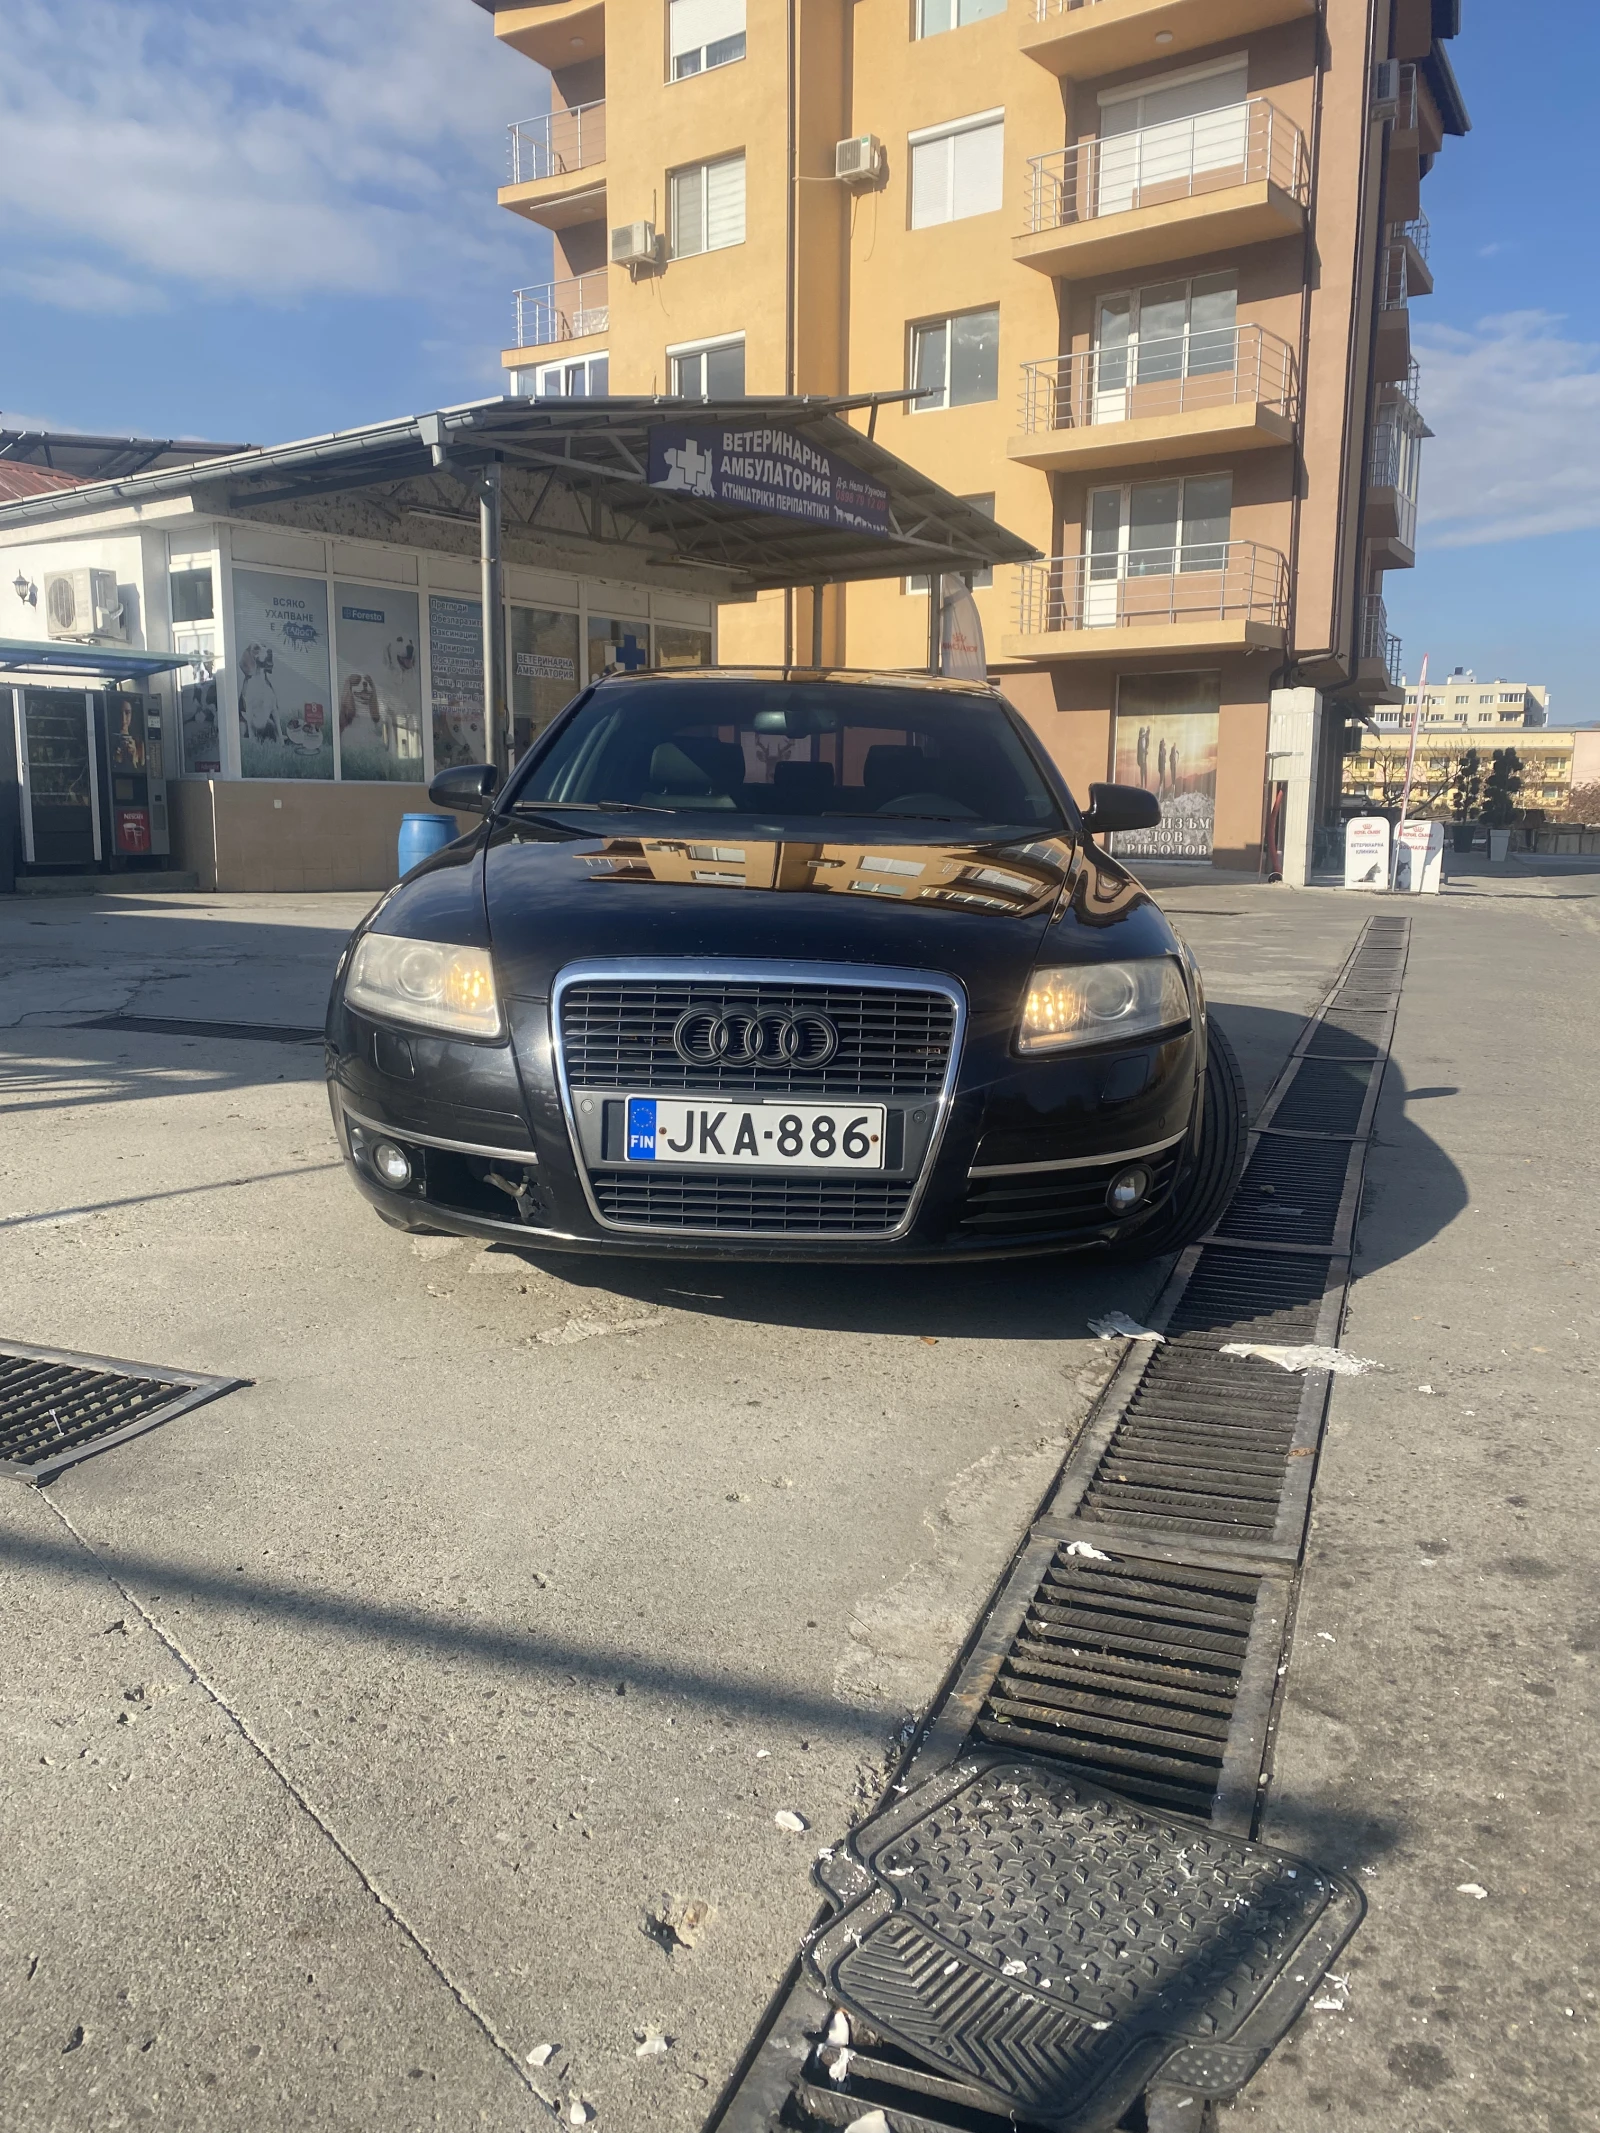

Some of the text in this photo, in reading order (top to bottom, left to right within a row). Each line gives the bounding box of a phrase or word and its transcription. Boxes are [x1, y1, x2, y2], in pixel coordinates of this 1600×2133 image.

[723, 429, 830, 476] ВЕТЕРИНАРНА
[720, 455, 830, 498] АМБУЛАТОРИЯ
[273, 597, 305, 609] ВСЯКО
[431, 599, 468, 612] Прегледи
[265, 608, 313, 622] УХАПВАНЕ
[352, 609, 382, 621] Foresto
[270, 622, 313, 638] Е ГАДОСТ
[431, 626, 478, 641] Ваксинации
[432, 640, 474, 654] Маркиране
[517, 653, 575, 669] ВЕТЕРИНАРНА
[516, 665, 575, 680] АМБУЛАТОРИЯ
[311, 702, 318, 713] 8
[1148, 831, 1183, 842] ЛОВ
[1126, 843, 1207, 855] РИБОЛОВ
[630, 1110, 870, 1159] FIN JKA-886
